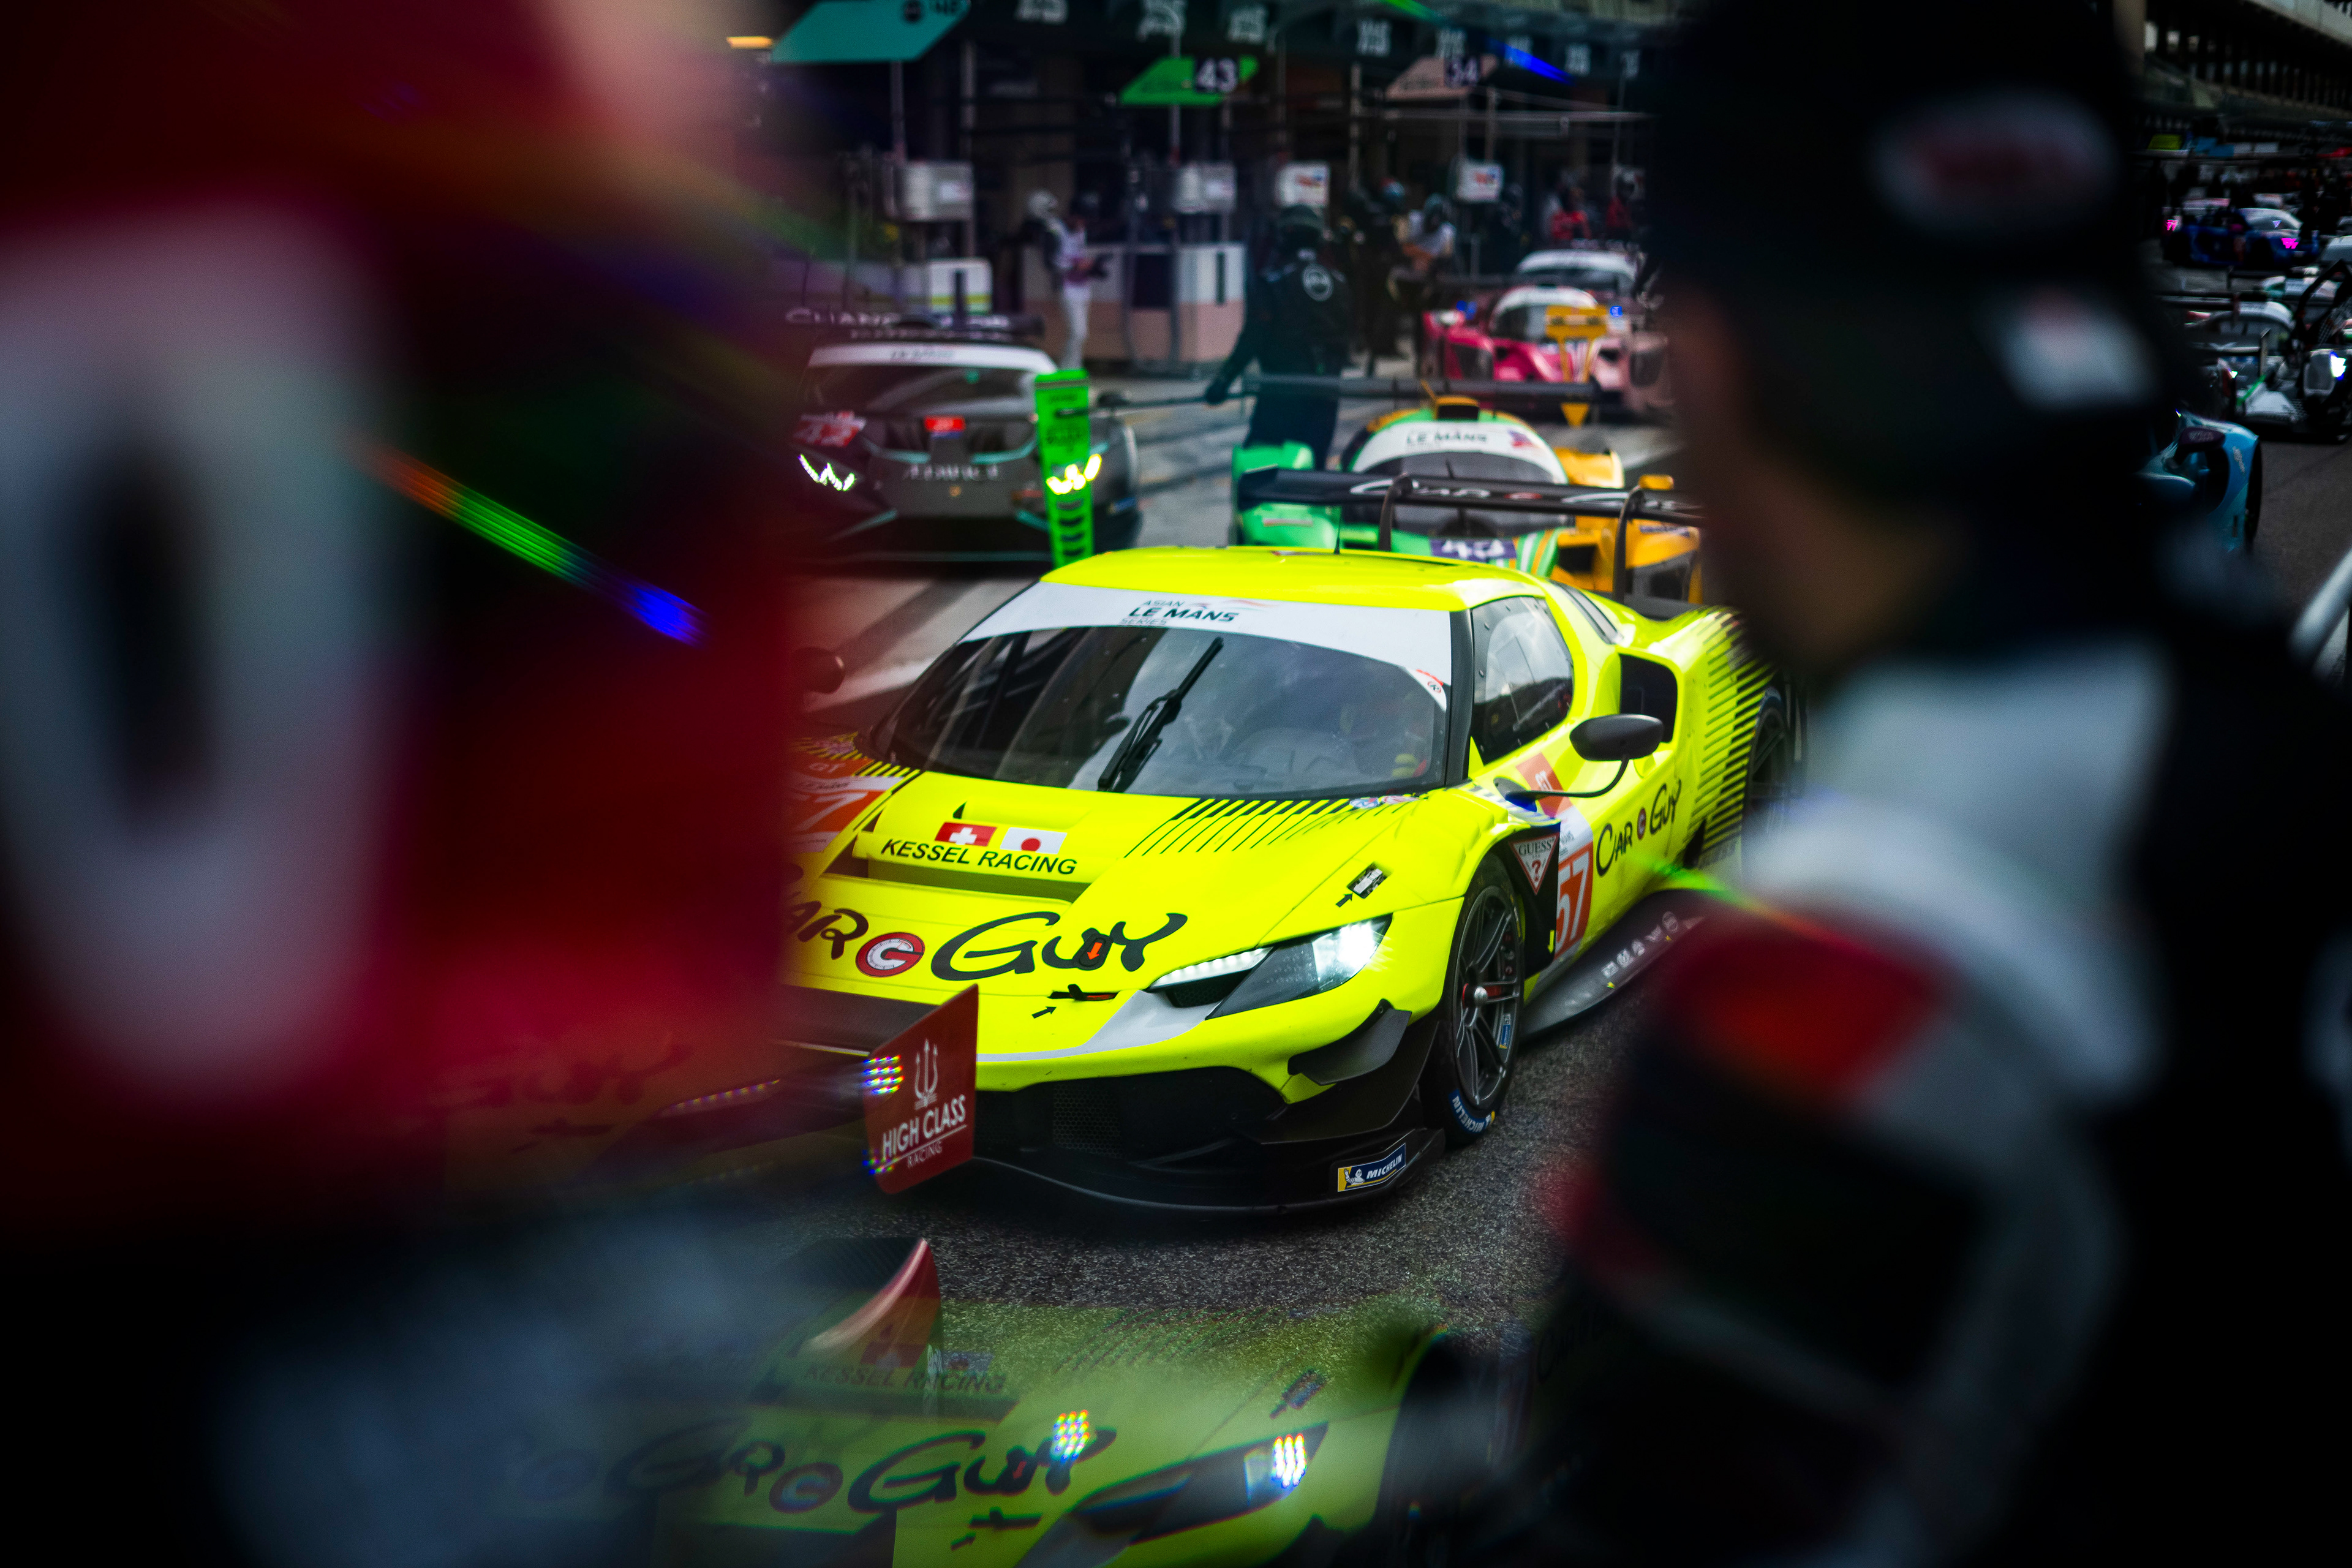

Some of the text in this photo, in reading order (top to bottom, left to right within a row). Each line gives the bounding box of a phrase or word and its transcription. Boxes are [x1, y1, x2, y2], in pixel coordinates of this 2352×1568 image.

[1128, 607, 1240, 622] LE MANS
[881, 839, 1077, 875] KESSEL RACING
[1518, 838, 1552, 856] GUESS
[1555, 851, 1589, 951] 57
[883, 1094, 966, 1161] HIGH CLASS
[1452, 1096, 1485, 1133] MICHELIN
[907, 1140, 943, 1169] RACING
[1366, 1154, 1403, 1180] MICHELIN
